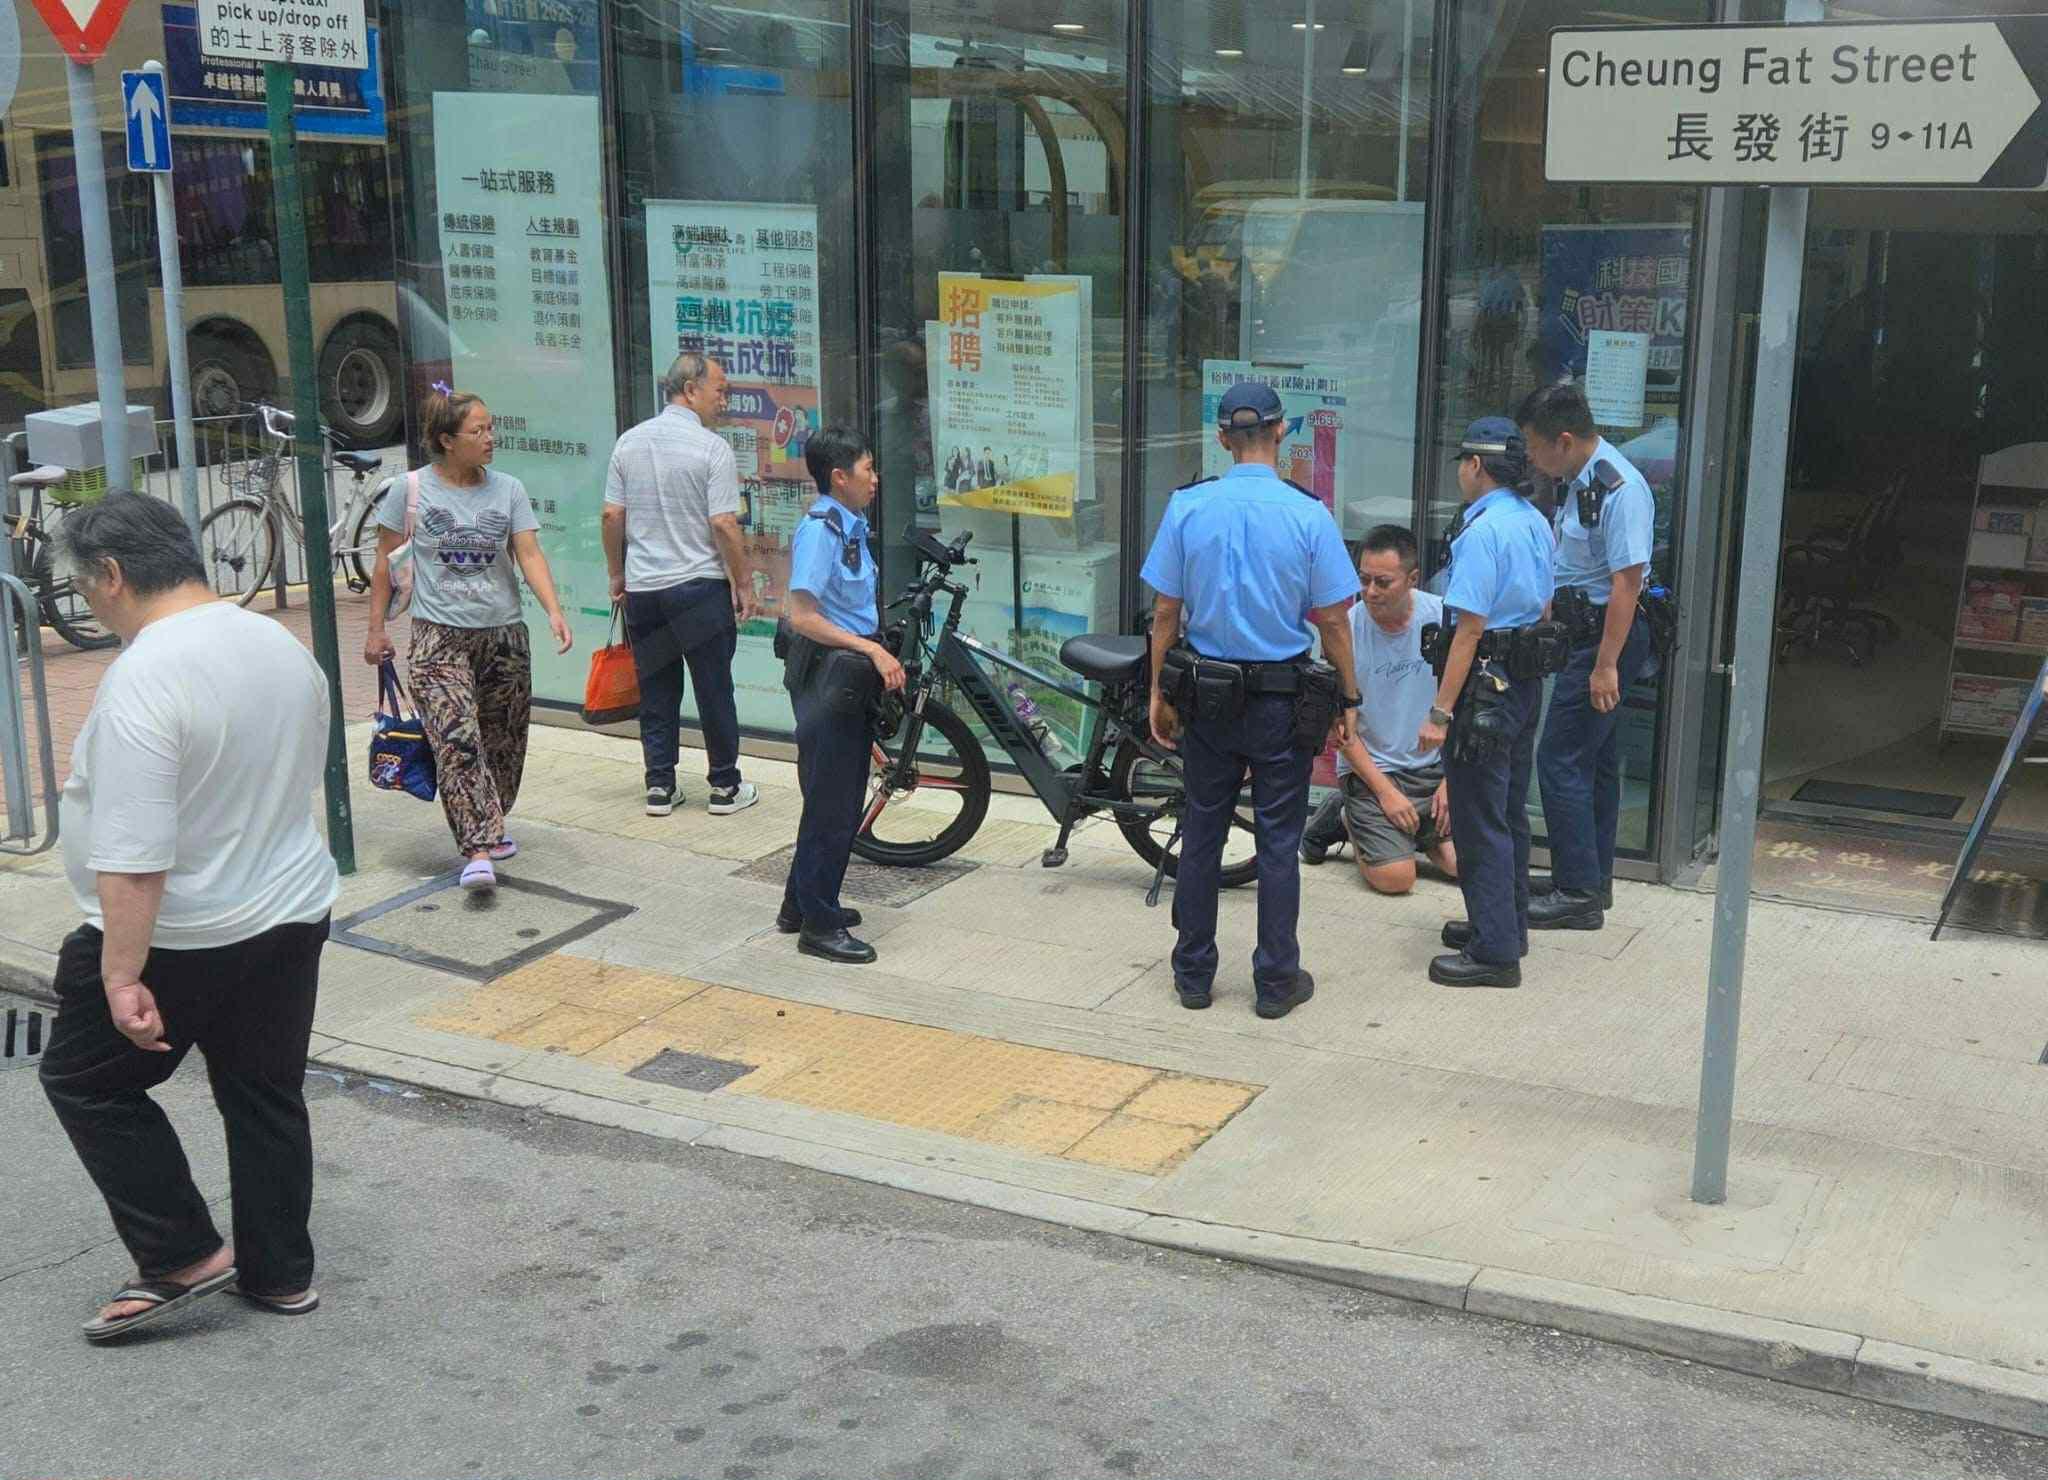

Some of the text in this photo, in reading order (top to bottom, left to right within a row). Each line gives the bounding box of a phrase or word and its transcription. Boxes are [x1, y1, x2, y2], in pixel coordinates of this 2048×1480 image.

[217, 3, 348, 30] pick up/drop off
[211, 27, 358, 61] 的士上落客除外
[1562, 43, 1977, 92] Cheung Fat Street
[1667, 112, 1973, 162] 長發街 9 11A
[461, 168, 555, 194] 一站式服務
[525, 216, 579, 235] 人生規劃
[756, 228, 813, 248] 其他服務
[949, 286, 981, 373] 招聘
